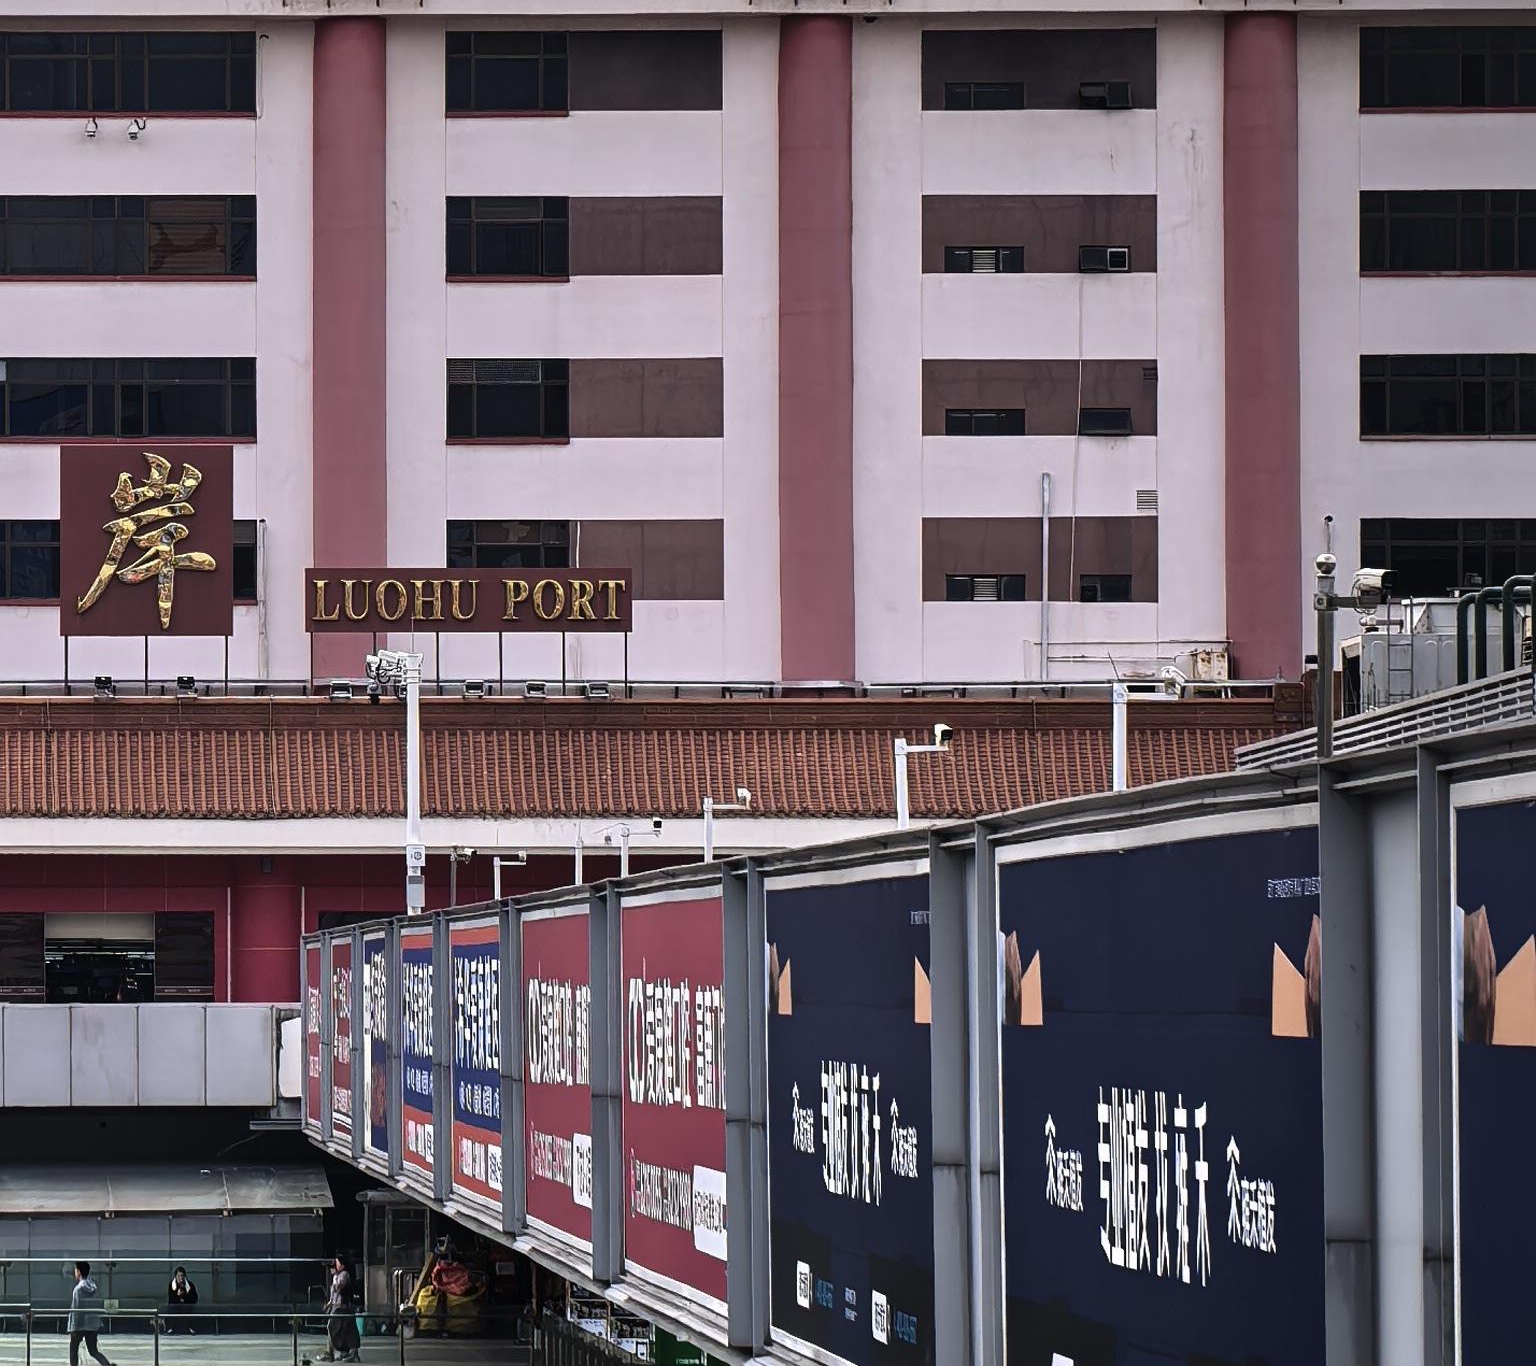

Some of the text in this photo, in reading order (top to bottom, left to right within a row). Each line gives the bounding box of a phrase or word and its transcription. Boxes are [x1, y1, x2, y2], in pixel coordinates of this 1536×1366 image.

[312, 578, 628, 622] LUOHU PORT
[645, 977, 693, 1109] 爱康健口腔
[1098, 1085, 1213, 1288] 专业植发找雍禾
